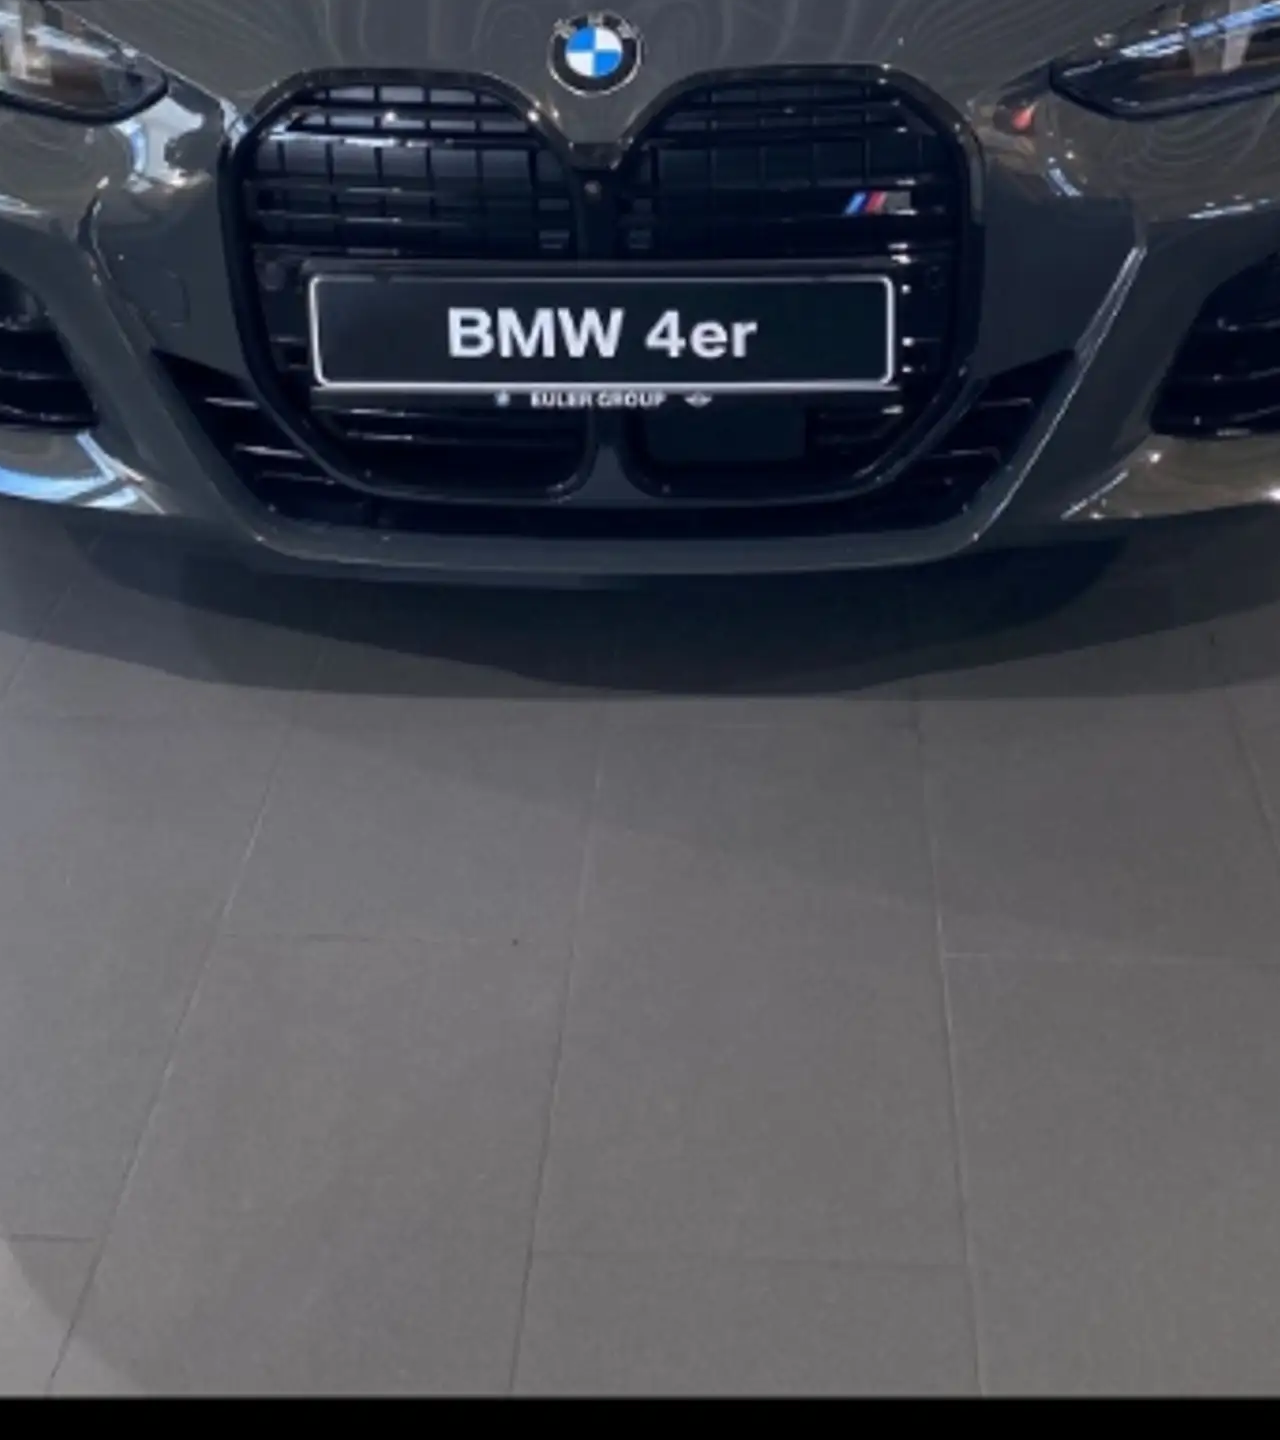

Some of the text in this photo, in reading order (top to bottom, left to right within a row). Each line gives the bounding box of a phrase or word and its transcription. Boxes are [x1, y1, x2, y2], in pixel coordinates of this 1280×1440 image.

[448, 307, 757, 359] BMW 4er
[530, 390, 667, 407] EULER GROUP
